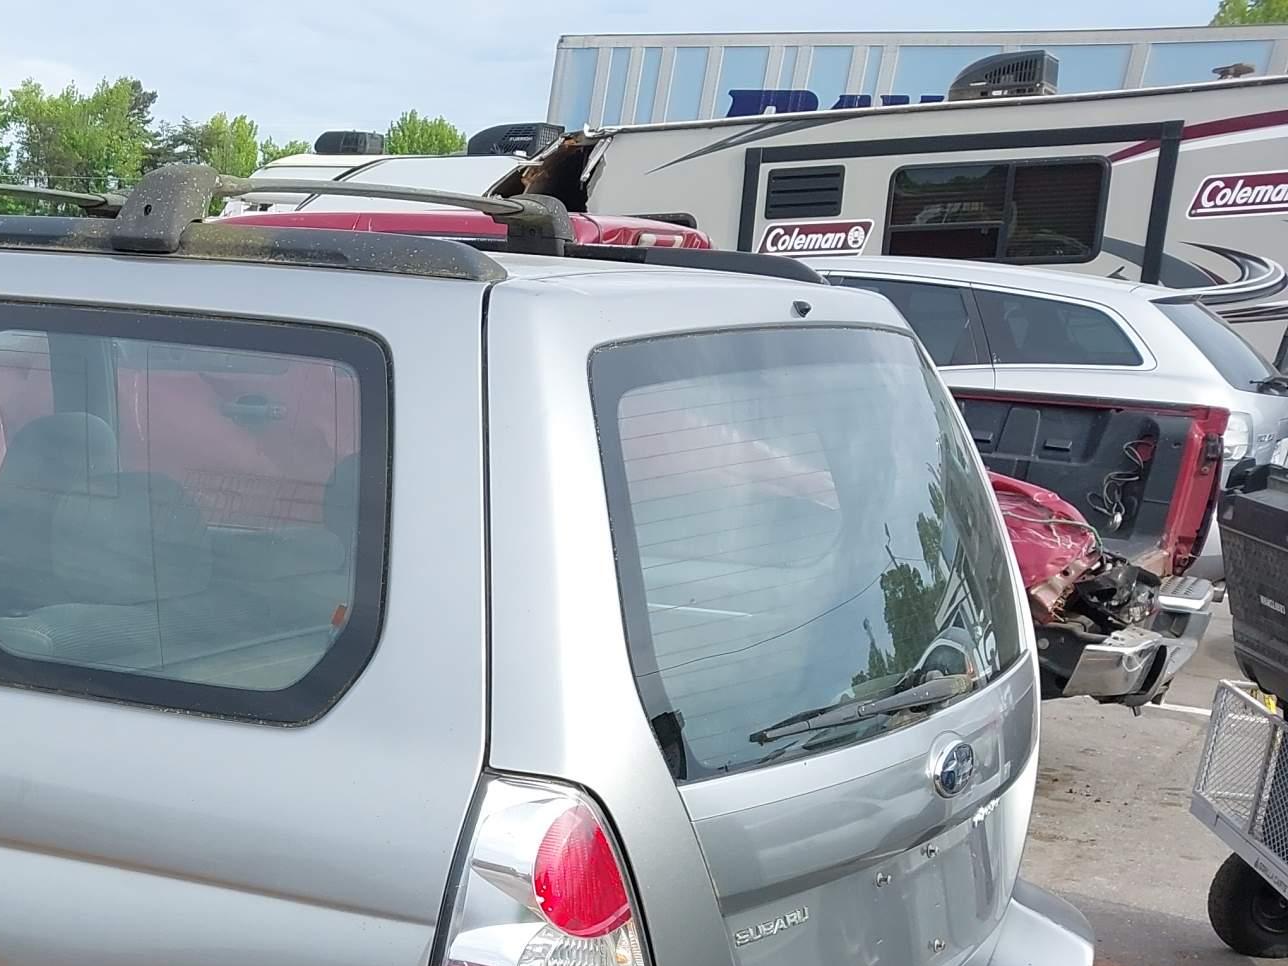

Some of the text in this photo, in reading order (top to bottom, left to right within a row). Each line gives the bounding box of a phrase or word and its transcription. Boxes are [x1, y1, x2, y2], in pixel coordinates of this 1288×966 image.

[1201, 179, 1288, 208] Colema
[766, 227, 845, 251] Coleman
[735, 906, 809, 947] SUBARU
